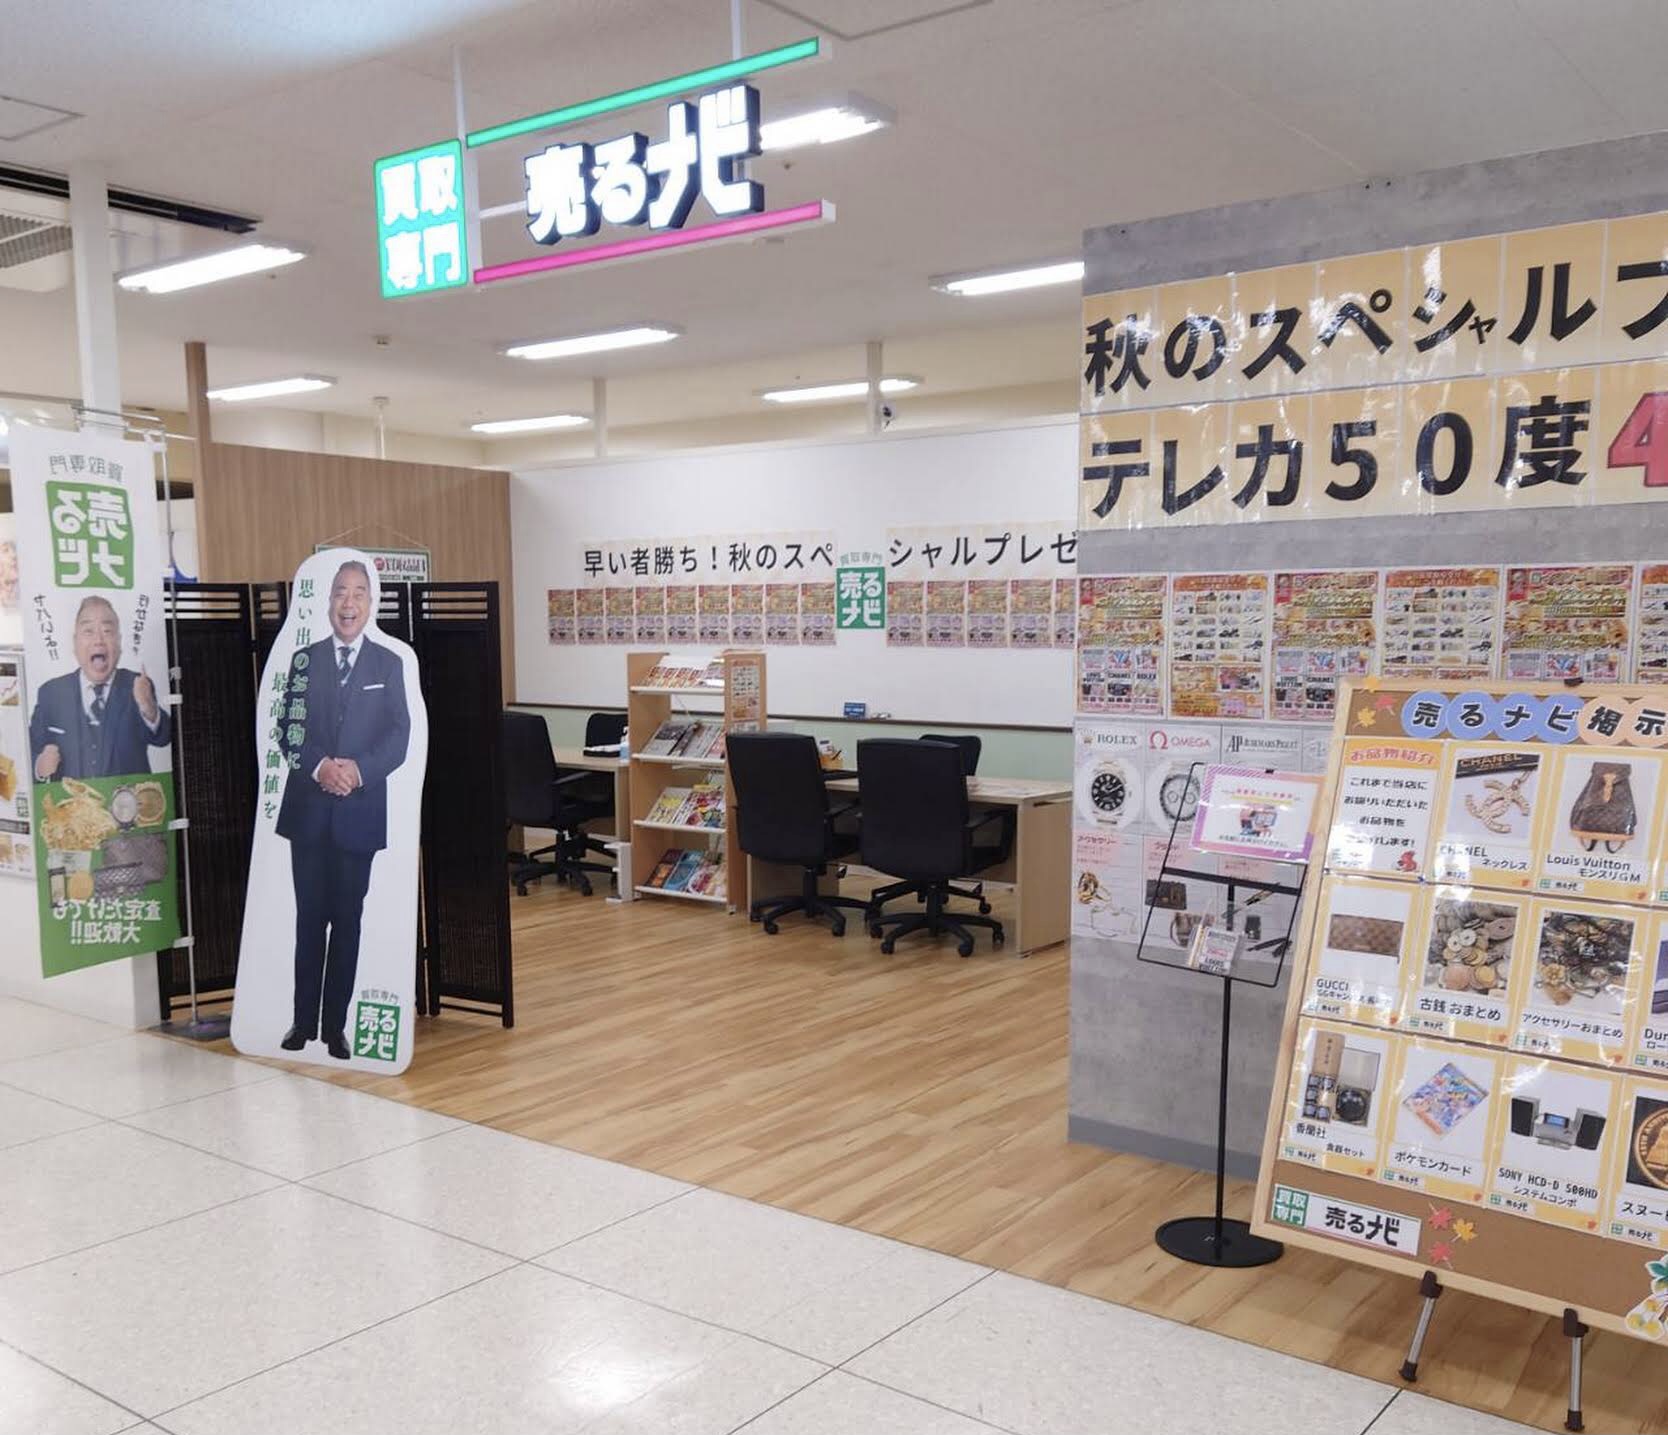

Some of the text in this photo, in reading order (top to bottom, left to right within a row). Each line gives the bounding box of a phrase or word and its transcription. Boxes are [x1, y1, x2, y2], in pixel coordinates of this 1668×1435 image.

[525, 84, 764, 243] 売るナビ
[380, 154, 458, 225] 買取
[386, 222, 463, 289] 専門
[584, 543, 834, 577] 早い者勝ち！秋のスペ
[889, 531, 1078, 568] シャルプレゼ
[840, 571, 882, 599] 売る
[842, 600, 881, 627] ナビ
[287, 578, 314, 769] 思い出のお品物に
[1412, 701, 1667, 739] 売るナビ掲示
[263, 671, 289, 820] 最高の価値を
[1097, 734, 1138, 745] ROLEX
[1171, 737, 1211, 748] OMEGA
[1350, 747, 1435, 764] お品物紹介
[1460, 753, 1522, 768] CHANEL
[1349, 777, 1428, 790] これまで当店に
[1359, 815, 1406, 827] お品物を
[1546, 853, 1632, 871] Louis Vuitton
[1316, 978, 1349, 991] GUCCI
[359, 1005, 397, 1032] 売る
[1420, 998, 1502, 1021] 古銭 おまとめ
[1522, 1012, 1624, 1039] アクセサリーおまとめ
[358, 1032, 394, 1059] ナビ
[1394, 1151, 1473, 1177] ポケモンカード
[1499, 1167, 1522, 1182] SONY
[1278, 1189, 1307, 1208] 買取
[1621, 1200, 1668, 1221] スヌー
[1275, 1206, 1304, 1225] 専門
[1325, 1206, 1401, 1247] 売るナビ
